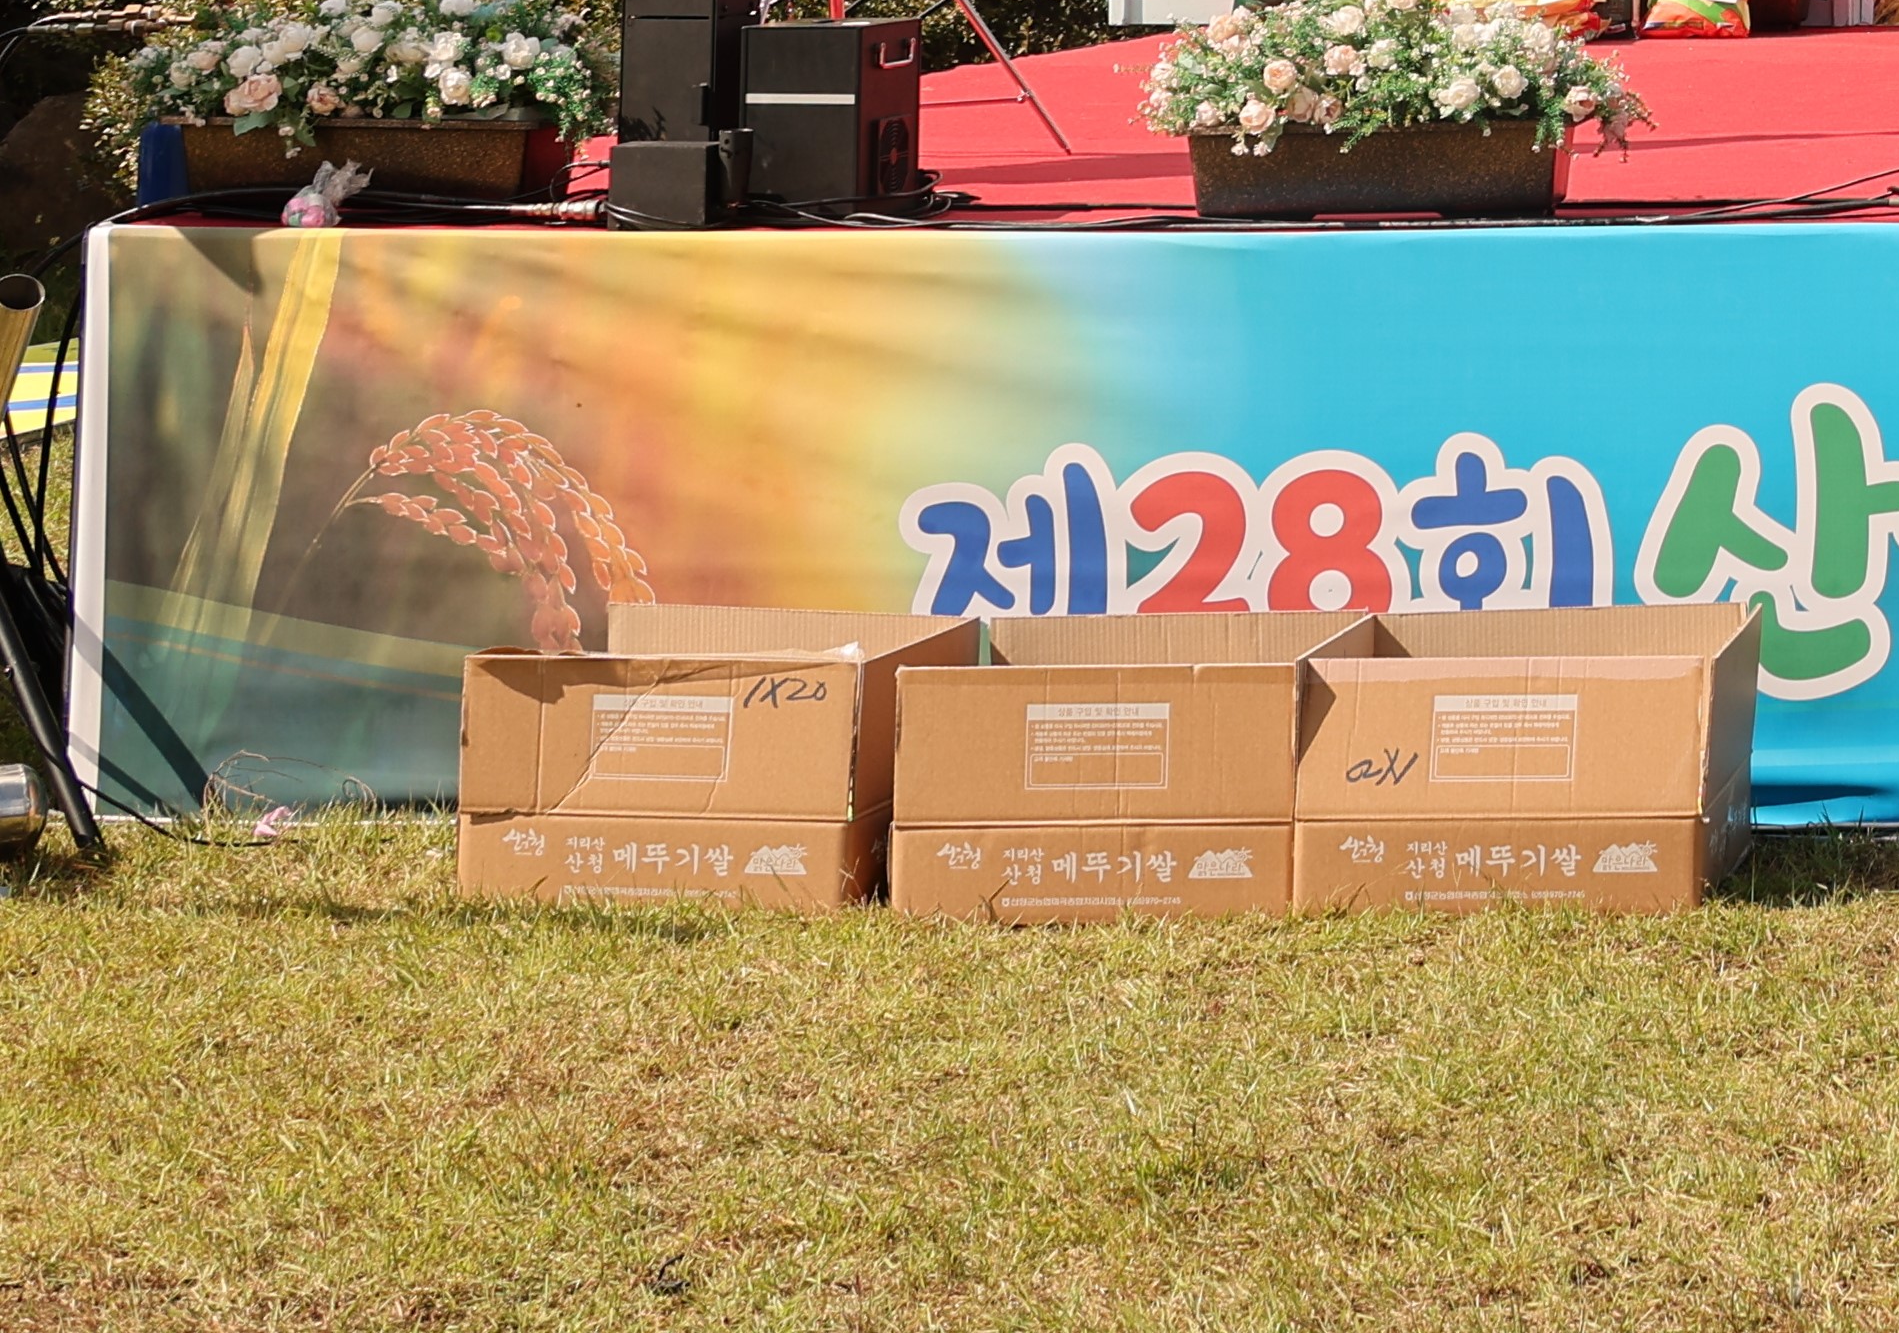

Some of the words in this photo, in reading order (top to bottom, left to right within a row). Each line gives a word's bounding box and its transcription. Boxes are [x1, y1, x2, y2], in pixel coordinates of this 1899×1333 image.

[914, 431, 1600, 612] 제28회
[563, 852, 604, 874] 산청
[612, 841, 734, 877] 메뚜기쌀
[565, 836, 606, 851] 지리산
[1002, 847, 1045, 863] 지리산
[1404, 856, 1446, 880] 산청
[1454, 843, 1583, 878] 메뚜기쌀
[1406, 840, 1449, 856] 지리산
[1001, 864, 1042, 886] 산청
[1051, 849, 1177, 885] 메뚜기쌀
